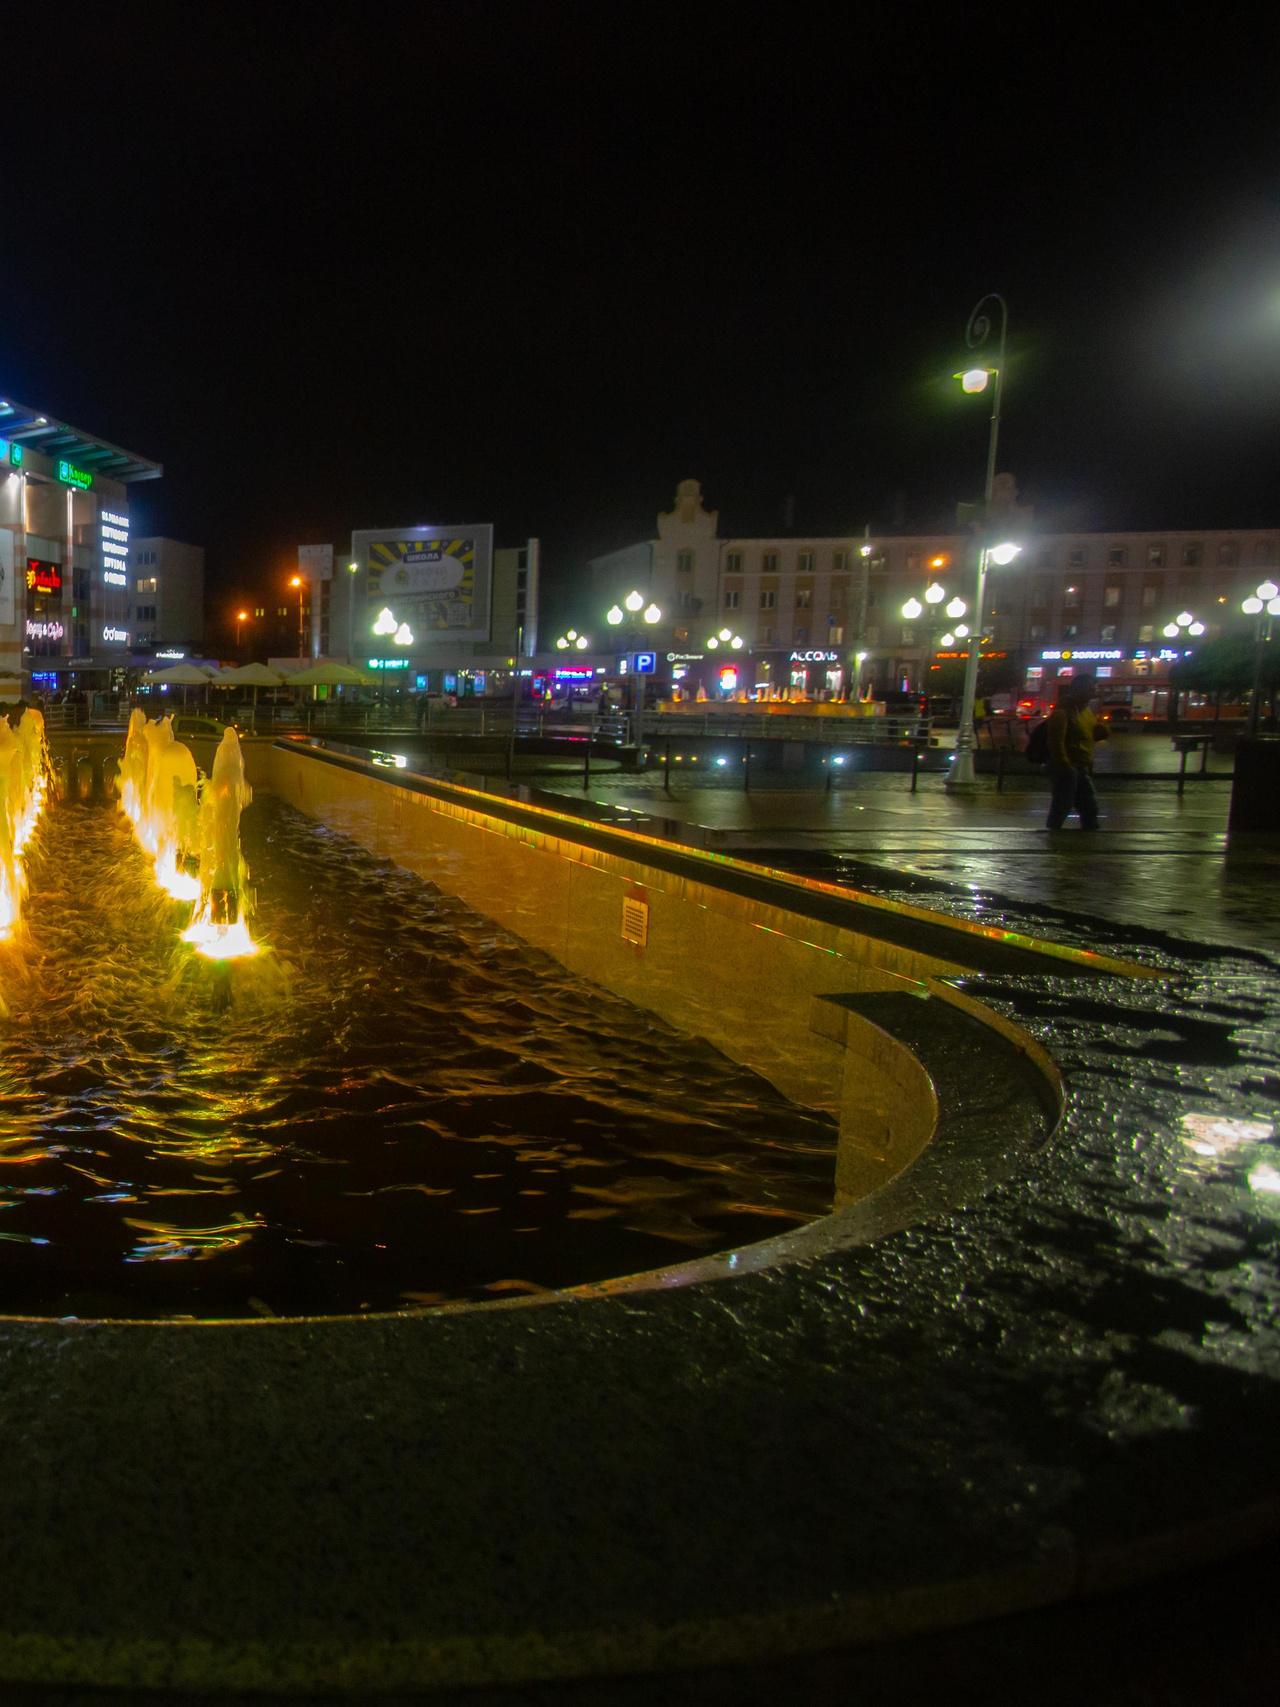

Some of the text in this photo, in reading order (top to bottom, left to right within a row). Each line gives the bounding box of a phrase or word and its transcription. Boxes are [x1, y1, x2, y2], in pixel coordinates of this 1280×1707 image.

[407, 552, 440, 562] ШКОЛА
[790, 650, 838, 662] АССОЛЬ
[1071, 649, 1122, 660] ЗОЛОТОЙ
[637, 655, 651, 671] P
